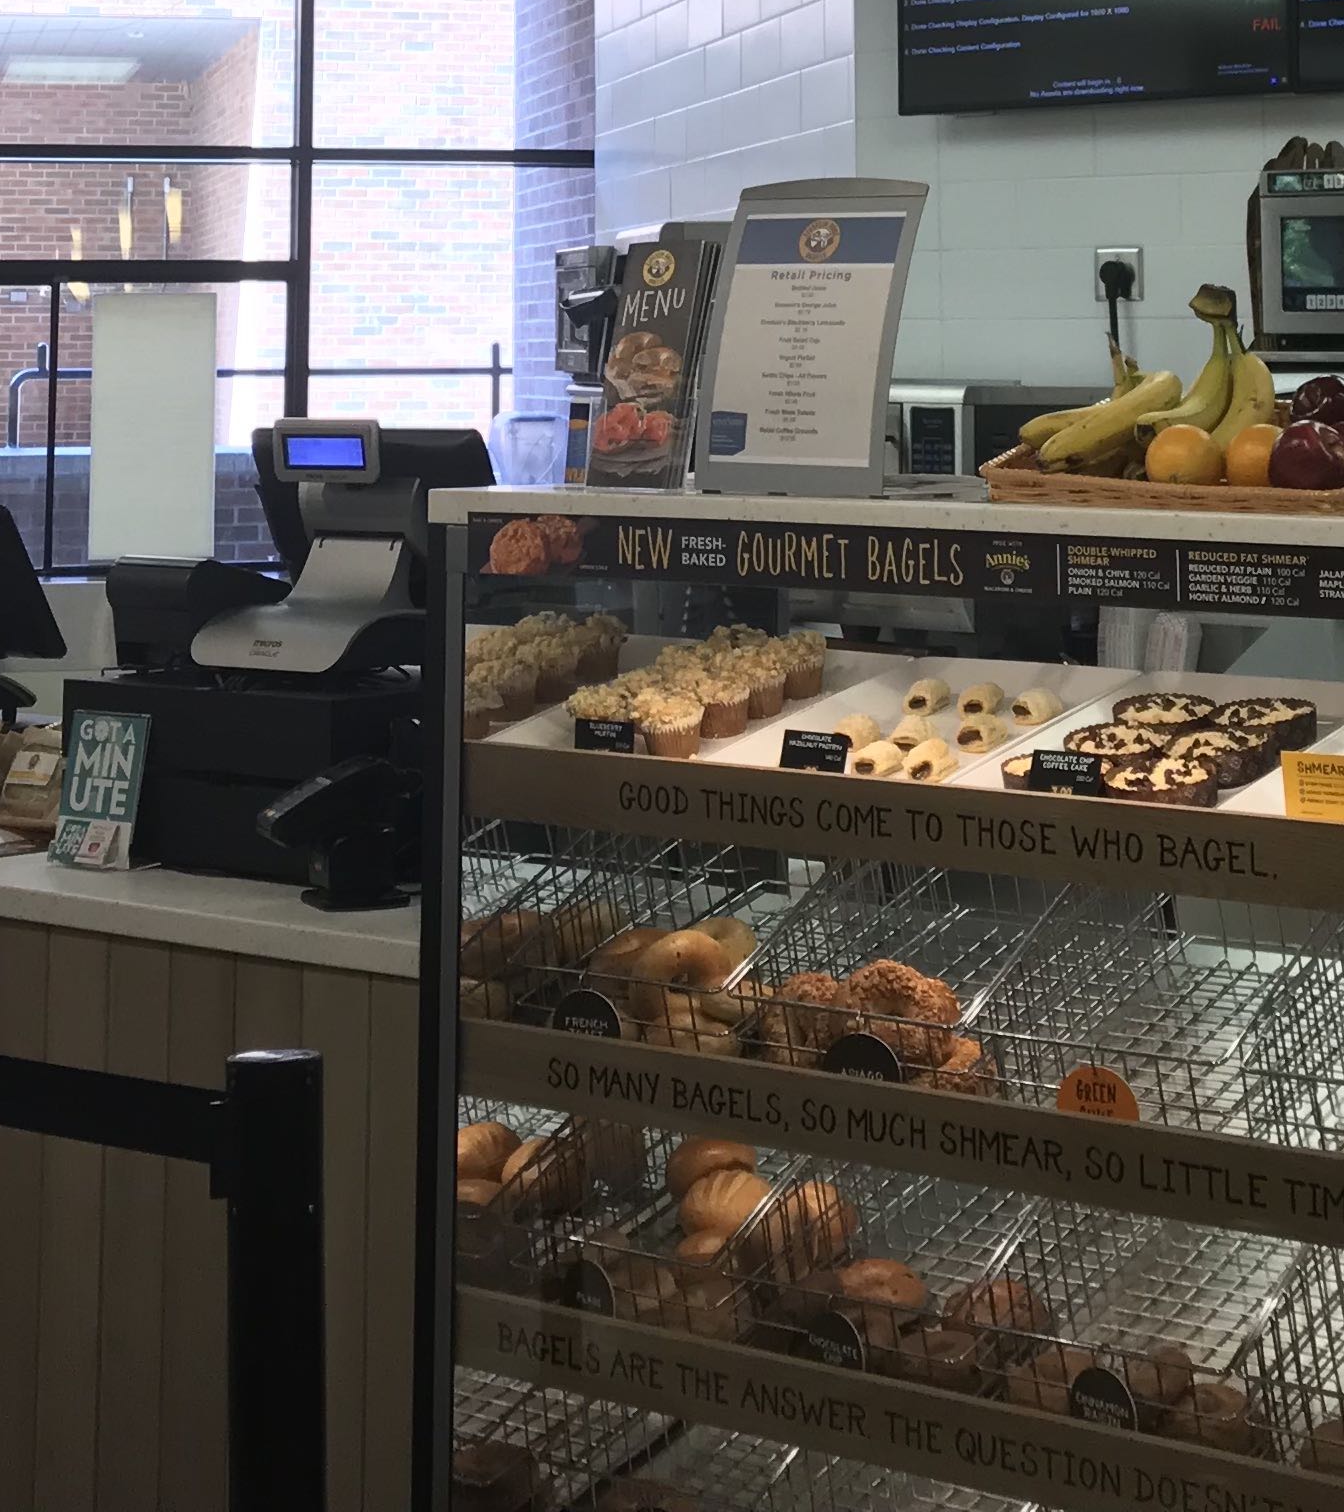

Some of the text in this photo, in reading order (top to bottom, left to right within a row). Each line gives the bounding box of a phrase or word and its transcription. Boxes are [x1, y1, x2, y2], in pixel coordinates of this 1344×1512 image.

[1253, 19, 1281, 32] FAIL
[771, 270, 852, 282] Retail Pricing
[622, 288, 686, 327] MENU
[618, 525, 964, 586] NEW FRESH- GOURMET BAGELS
[1067, 545, 1156, 559] DOUBLE-WHIPPED
[1188, 551, 1238, 563] REDUCED
[1240, 552, 1259, 563] FAT
[681, 553, 726, 567] BAKED
[985, 550, 1031, 570] Annie's
[1067, 556, 1110, 567] SHMEAR
[1068, 568, 1095, 577] ONION
[1105, 569, 1130, 579] CHIVE
[1147, 570, 1160, 580] Cal
[1188, 564, 1228, 575] REDUCED
[1230, 565, 1245, 575] FAT
[1247, 566, 1272, 576] PLAIN
[1291, 568, 1305, 578] Cal
[1068, 577, 1102, 587] SMOKED
[1104, 578, 1140, 589] SALMON
[1156, 581, 1170, 590] Cal
[1188, 573, 1222, 583] GARDEN
[1224, 575, 1258, 585] VEGGIE
[1277, 577, 1291, 586] Cal
[1068, 586, 1092, 596] PLAIN
[1110, 588, 1123, 597] Cal
[1188, 583, 1219, 592] GARLIC
[1230, 584, 1253, 594] HERB
[1271, 587, 1285, 596] Cal
[1188, 593, 1219, 603] HONEY
[1221, 595, 1259, 605] ALMOND
[1287, 597, 1299, 607] Cal
[80, 717, 136, 744] GOT A
[589, 722, 623, 732] BLUEBERRY
[801, 733, 833, 743] CHOCOLATE
[74, 741, 135, 780] MIN
[1039, 754, 1095, 764] CHOCOLATE CHIP
[1043, 762, 1089, 772] COFFEE CAKE
[69, 777, 130, 815] UTE
[619, 781, 1278, 880] GOOD THINGS COME TO THOSE WHO BAGEL.
[565, 1016, 608, 1029] FRENCH
[1076, 1079, 1116, 1104] GREEN
[547, 1057, 580, 1090] SO
[589, 1066, 661, 1105] MANY
[671, 1076, 790, 1133] BAGELS,
[801, 1098, 837, 1135] SO
[847, 1108, 926, 1151] MUCH
[939, 1122, 1072, 1182] SHMEAR,
[1084, 1146, 1125, 1184] SO
[1139, 1153, 1268, 1208] LITTLE
[497, 1321, 602, 1376] BAGELS
[609, 1348, 664, 1391] ARE
[675, 1362, 730, 1406] THE
[884, 1410, 943, 1455] THE
[955, 1426, 1122, 1500] QUESTION
